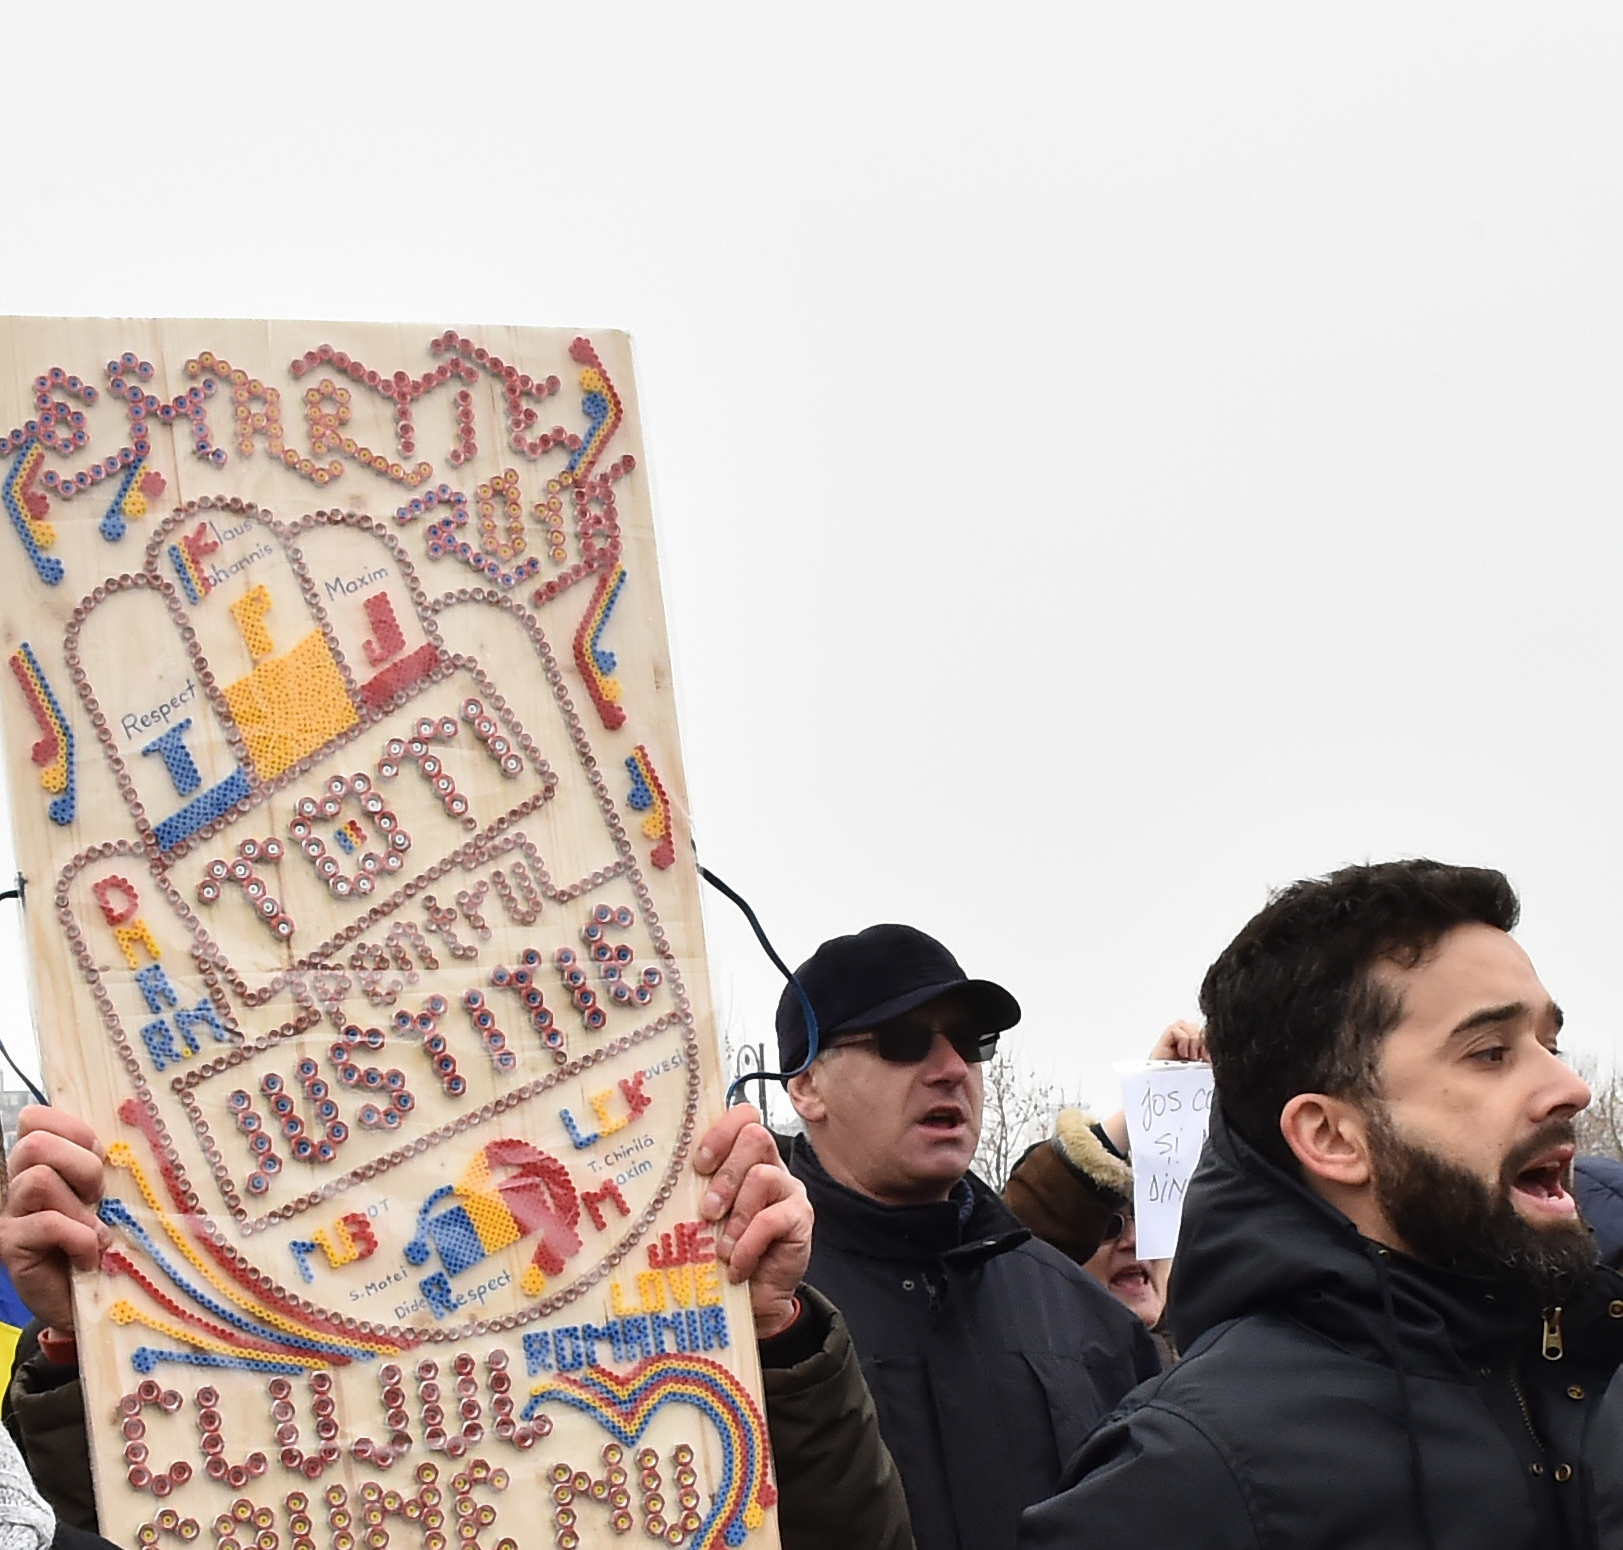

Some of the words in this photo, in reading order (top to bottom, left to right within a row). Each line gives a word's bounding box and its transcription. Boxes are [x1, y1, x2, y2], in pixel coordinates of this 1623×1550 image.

[324, 566, 389, 602] Maxim
[120, 680, 199, 740] Respect
[610, 1261, 723, 1318] LOVE
[522, 1304, 730, 1378] ROMANIA
[118, 1348, 554, 1498] CLUJUL
